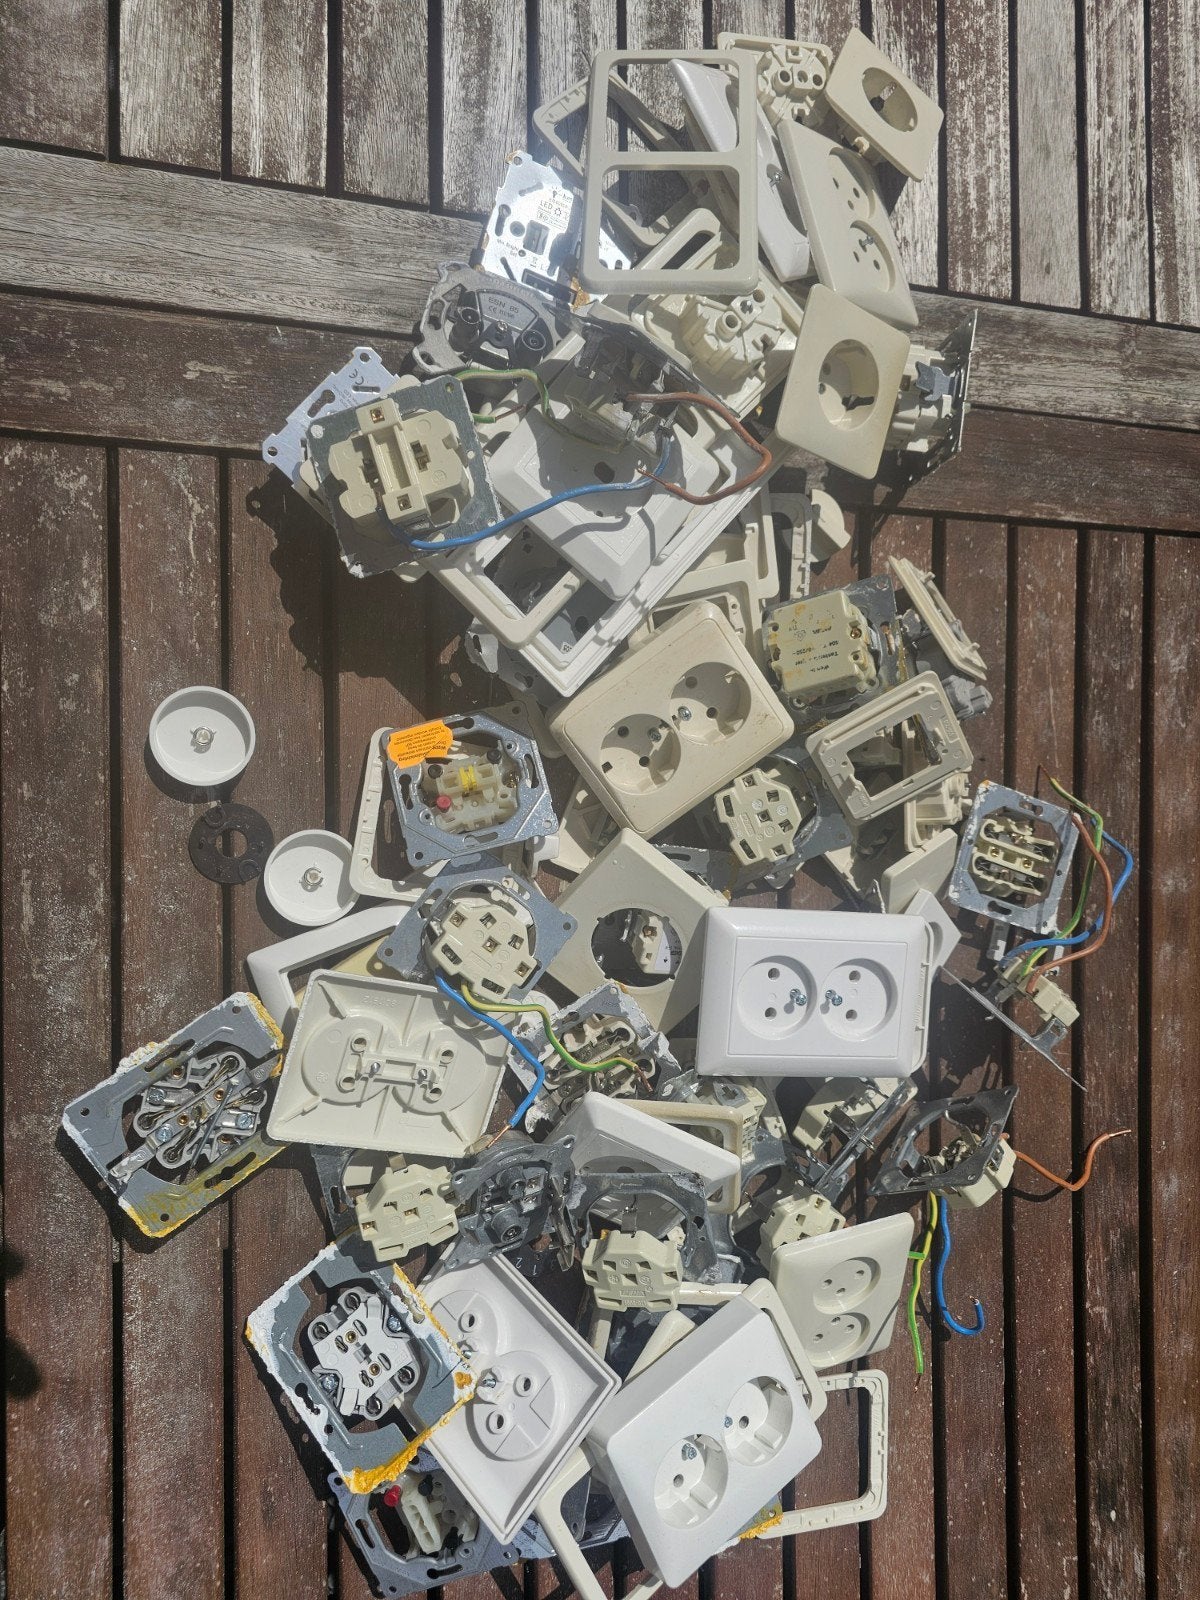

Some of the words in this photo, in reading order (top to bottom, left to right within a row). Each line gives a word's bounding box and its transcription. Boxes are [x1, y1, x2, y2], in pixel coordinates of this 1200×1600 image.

[540, 200, 553, 210] LED
[515, 1257, 523, 1269] 2
[532, 1264, 537, 1276] 1
